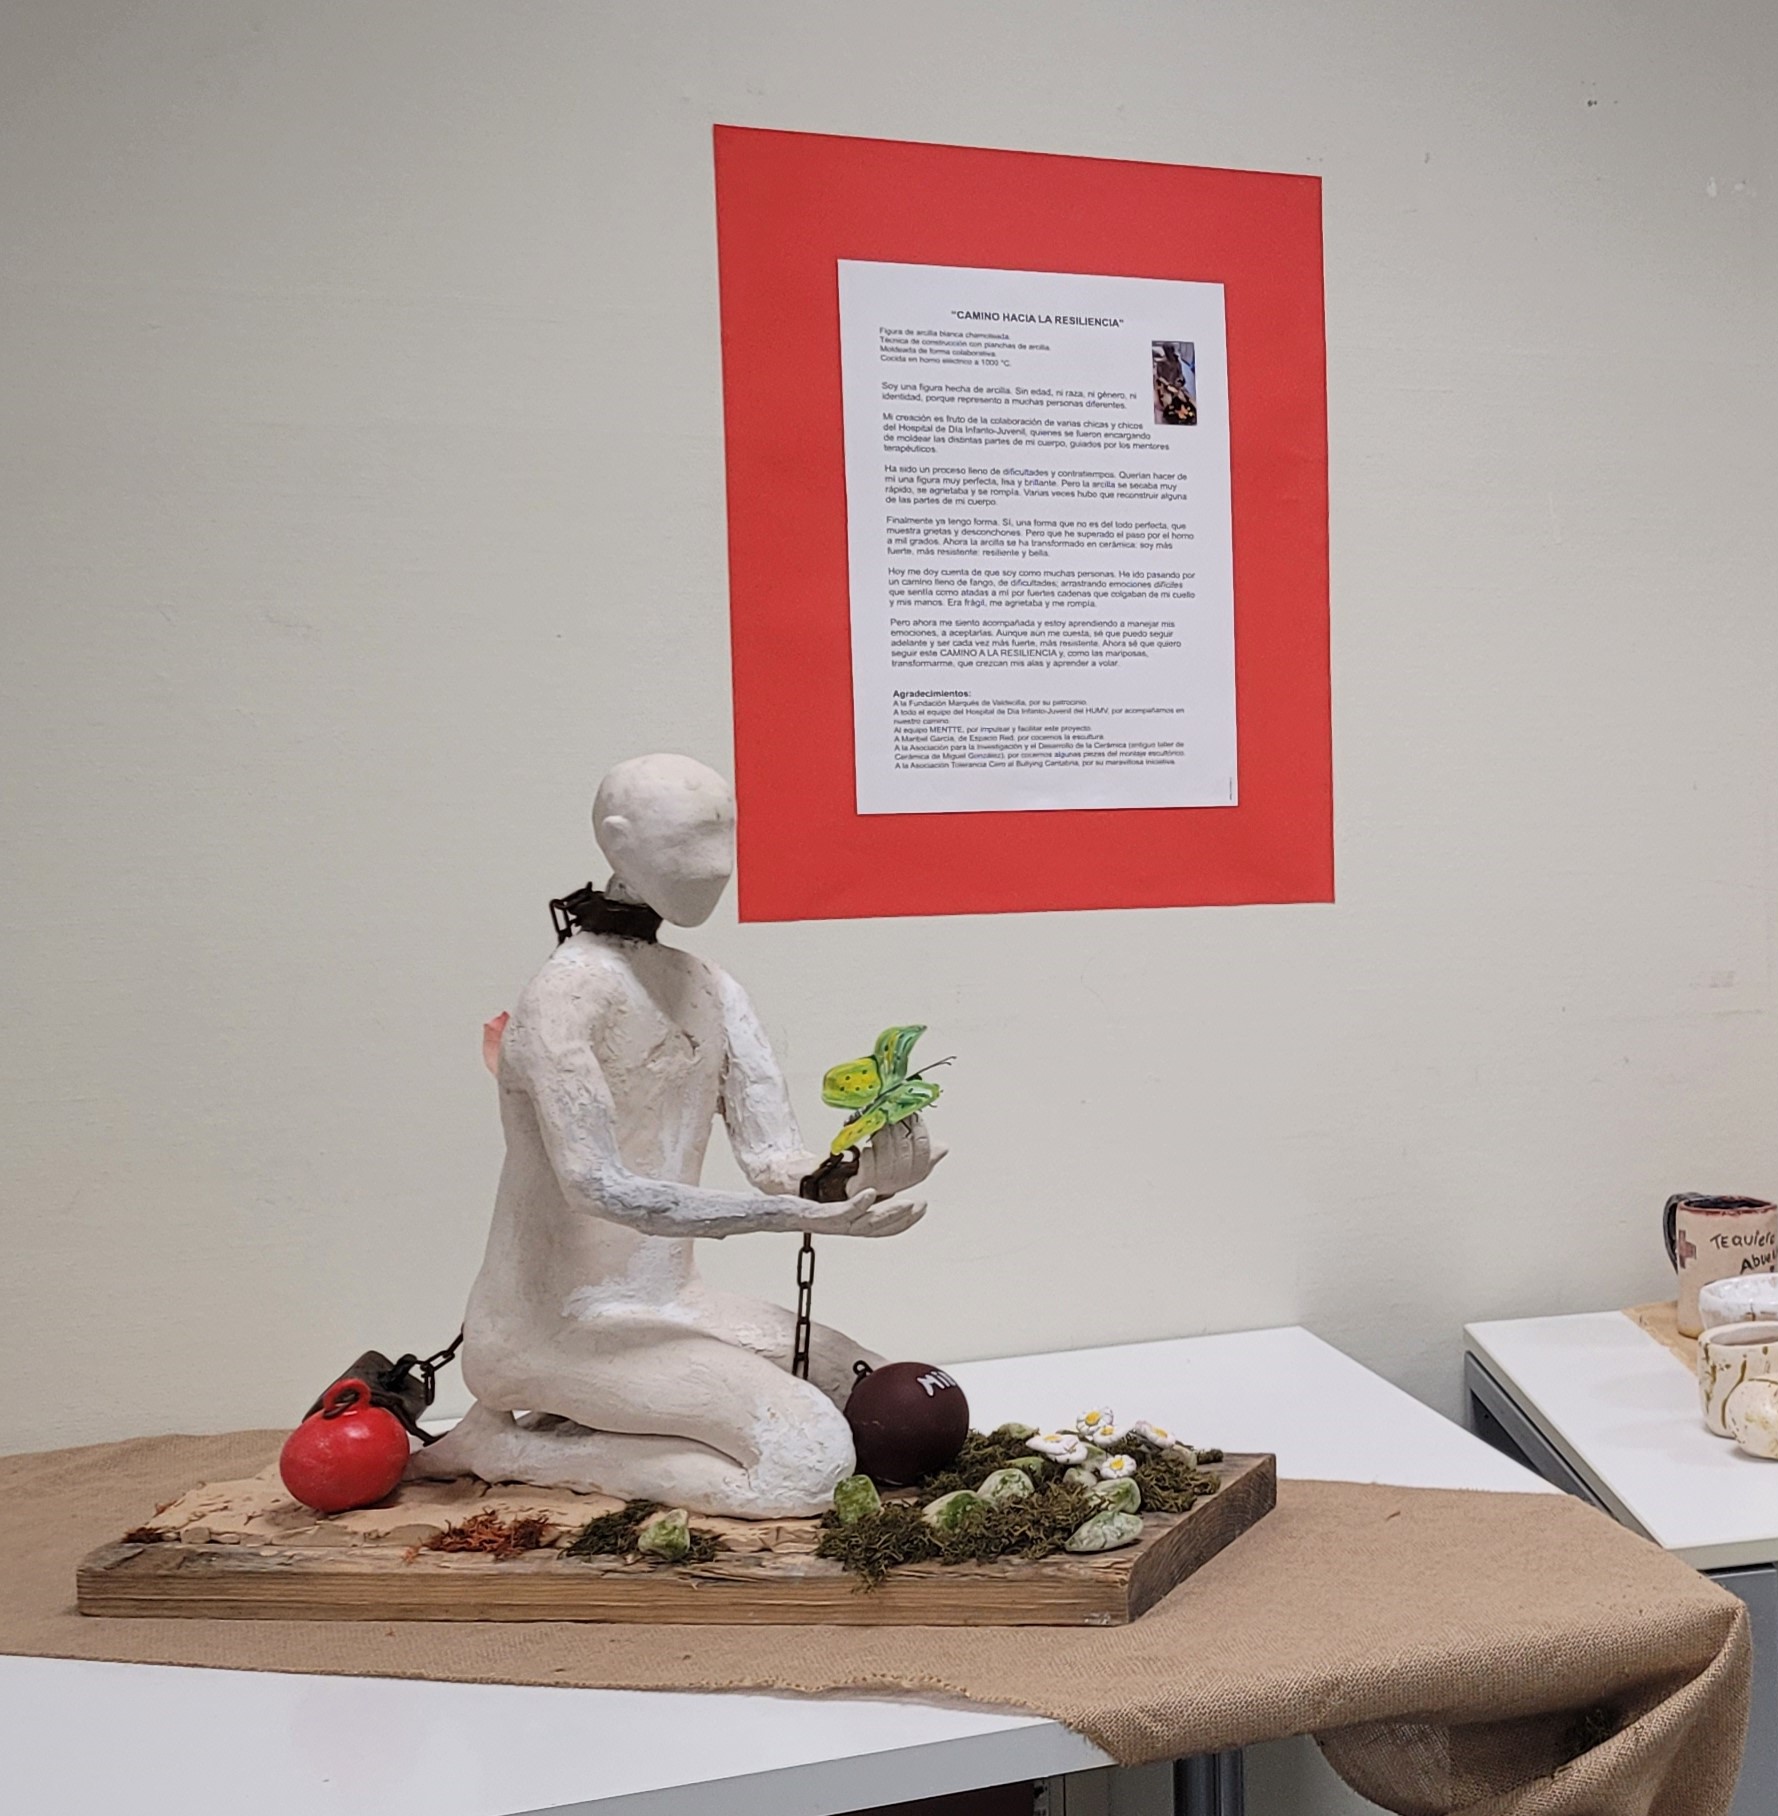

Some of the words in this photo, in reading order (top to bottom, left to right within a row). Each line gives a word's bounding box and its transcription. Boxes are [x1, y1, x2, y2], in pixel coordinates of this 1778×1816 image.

[1003, 314, 1036, 323] HACIA
[1038, 316, 1053, 324] LA
[893, 690, 972, 699] Agradecimientos:
